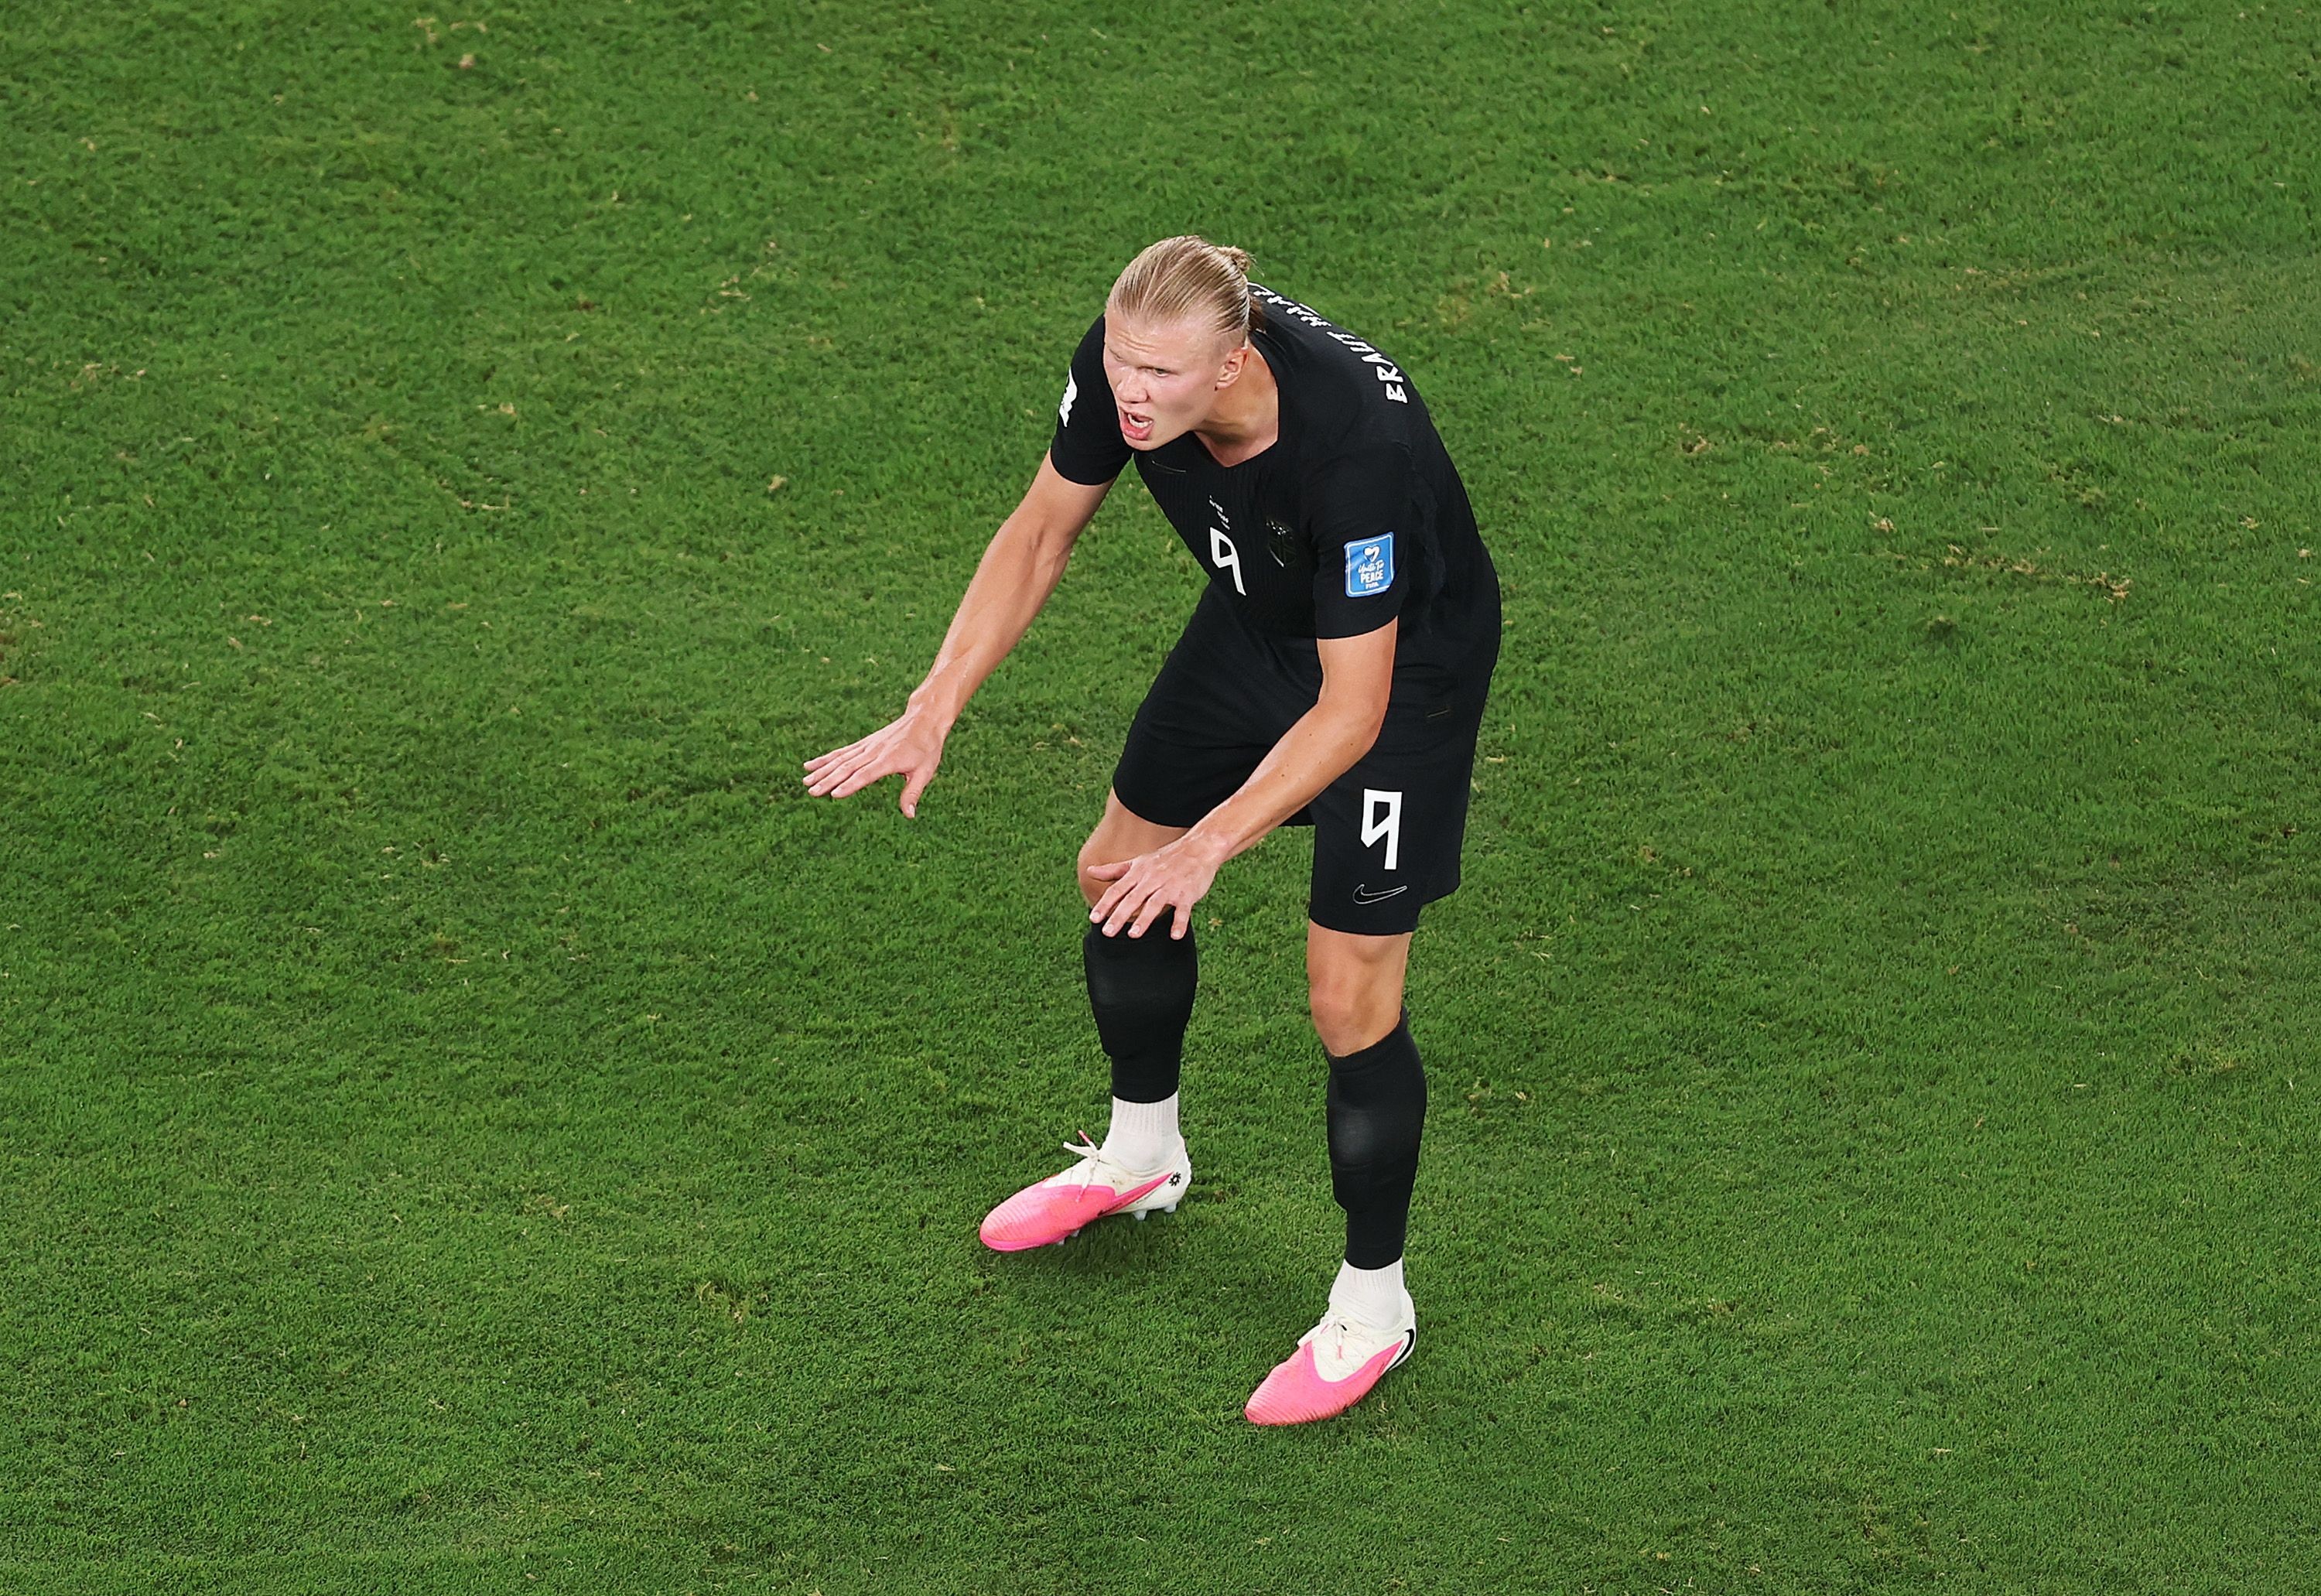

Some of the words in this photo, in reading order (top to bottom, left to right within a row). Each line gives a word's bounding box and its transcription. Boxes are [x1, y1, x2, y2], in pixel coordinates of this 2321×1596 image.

[1246, 282, 1331, 327] HAAL
[1326, 331, 1408, 404] BRAUT
[1209, 527, 1246, 596] 9
[1360, 569, 1384, 583] PEACE
[1361, 788, 1403, 870] 9
